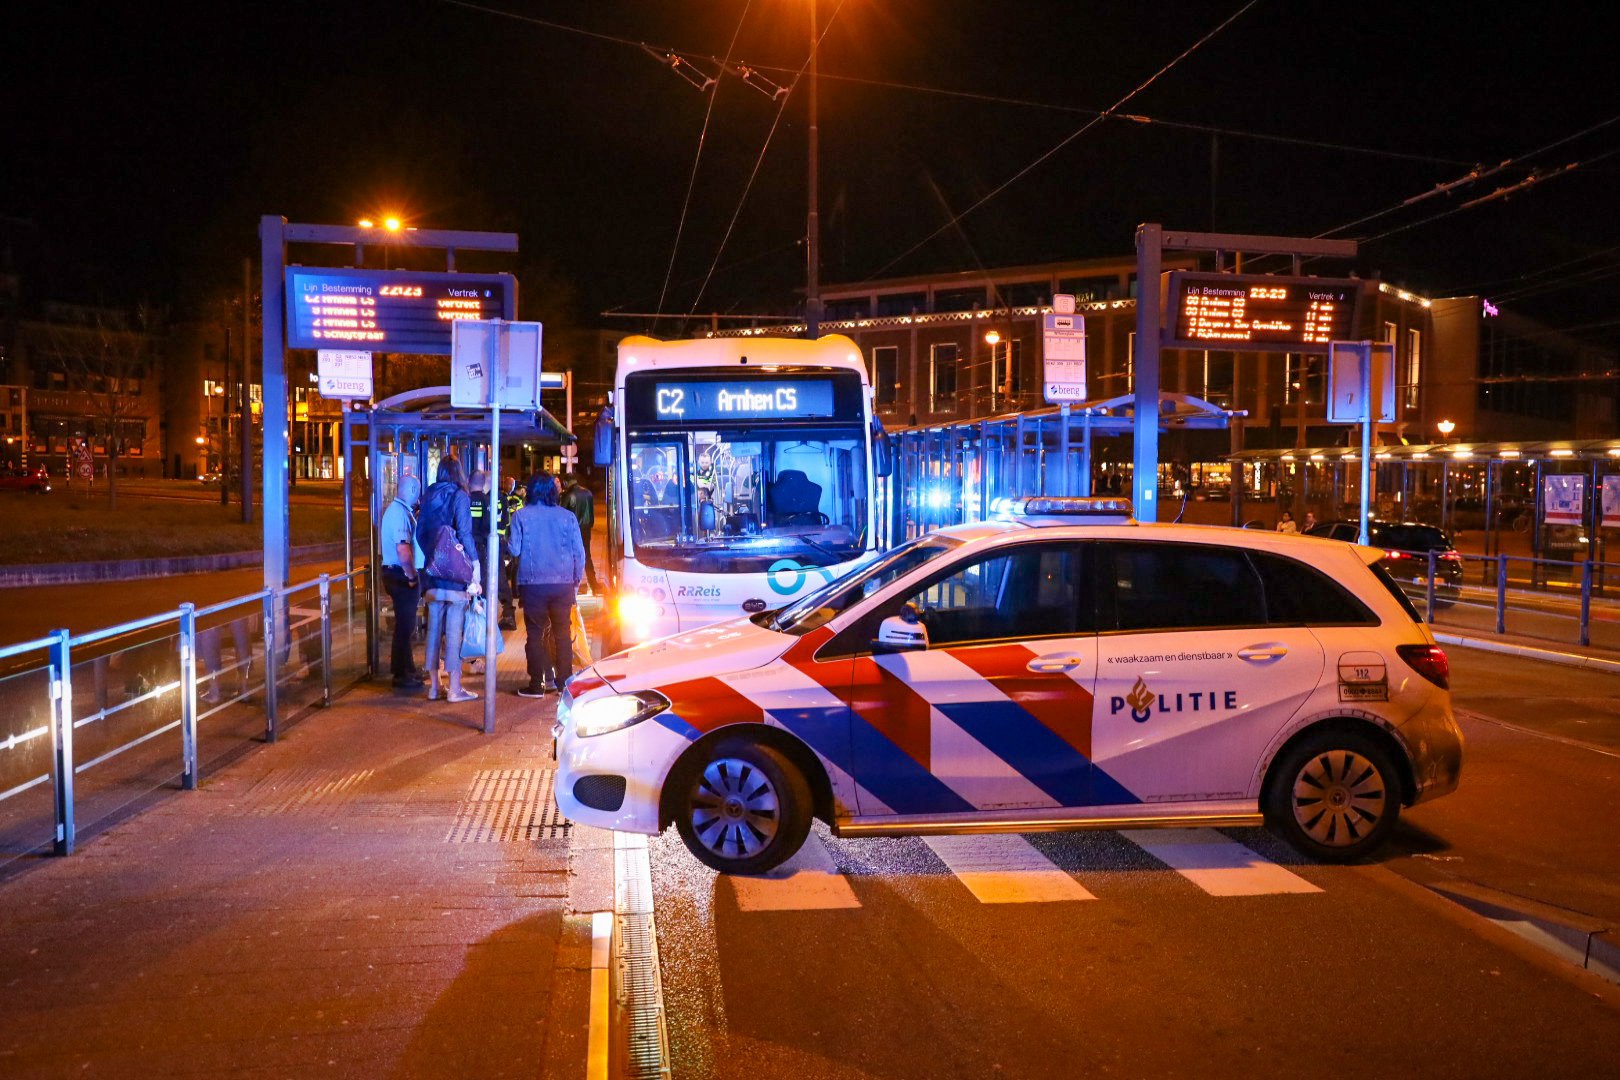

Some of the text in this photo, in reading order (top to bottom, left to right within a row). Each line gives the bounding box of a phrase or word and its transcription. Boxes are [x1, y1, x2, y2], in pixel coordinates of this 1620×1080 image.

[304, 283, 372, 296] Lijn Bestemming
[448, 288, 479, 298] Vertrek
[1187, 287, 1246, 298] Lijn Bestemming
[1309, 292, 1334, 300] Vertrek
[337, 379, 365, 393] breng
[1058, 385, 1080, 397] breng
[657, 387, 797, 414] C2 Arnhem CS
[641, 575, 665, 584] 2084
[678, 585, 721, 597] RRReis
[1114, 654, 1164, 664] waakzaam
[1165, 653, 1177, 662] en
[1177, 650, 1226, 661] dienstbaar
[1111, 690, 1237, 723] POLITIE
